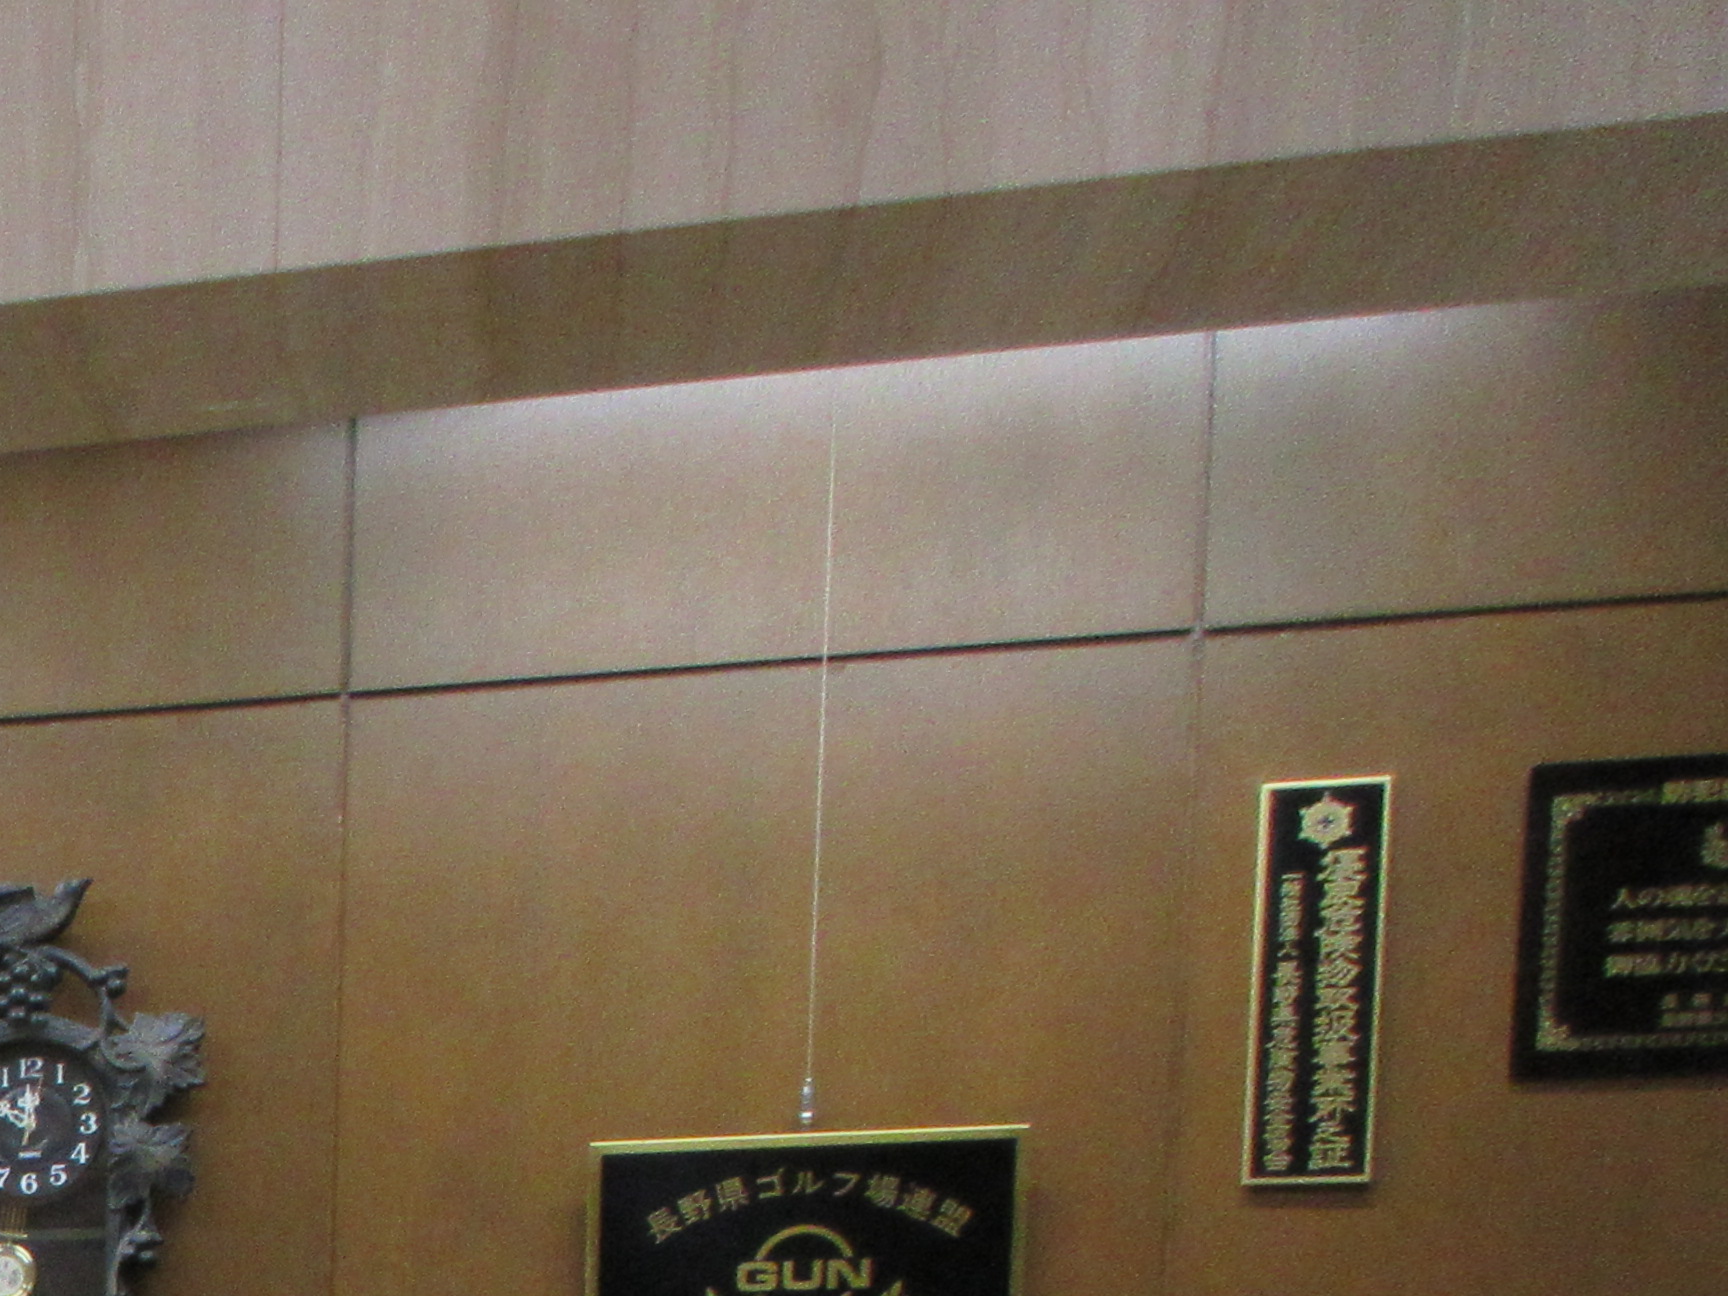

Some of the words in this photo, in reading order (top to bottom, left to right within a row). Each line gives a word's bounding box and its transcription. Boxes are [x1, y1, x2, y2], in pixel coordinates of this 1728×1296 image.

[20, 1057, 43, 1078] 12
[56, 1062, 65, 1084] 1
[73, 1083, 91, 1105] 2
[79, 1112, 98, 1134] 3
[69, 1142, 89, 1164] 4
[20, 1172, 38, 1195] 6
[49, 1164, 67, 1186] 5
[646, 1166, 974, 1244] 長野県ゴルフ場連盟
[737, 1257, 873, 1292] GUN
